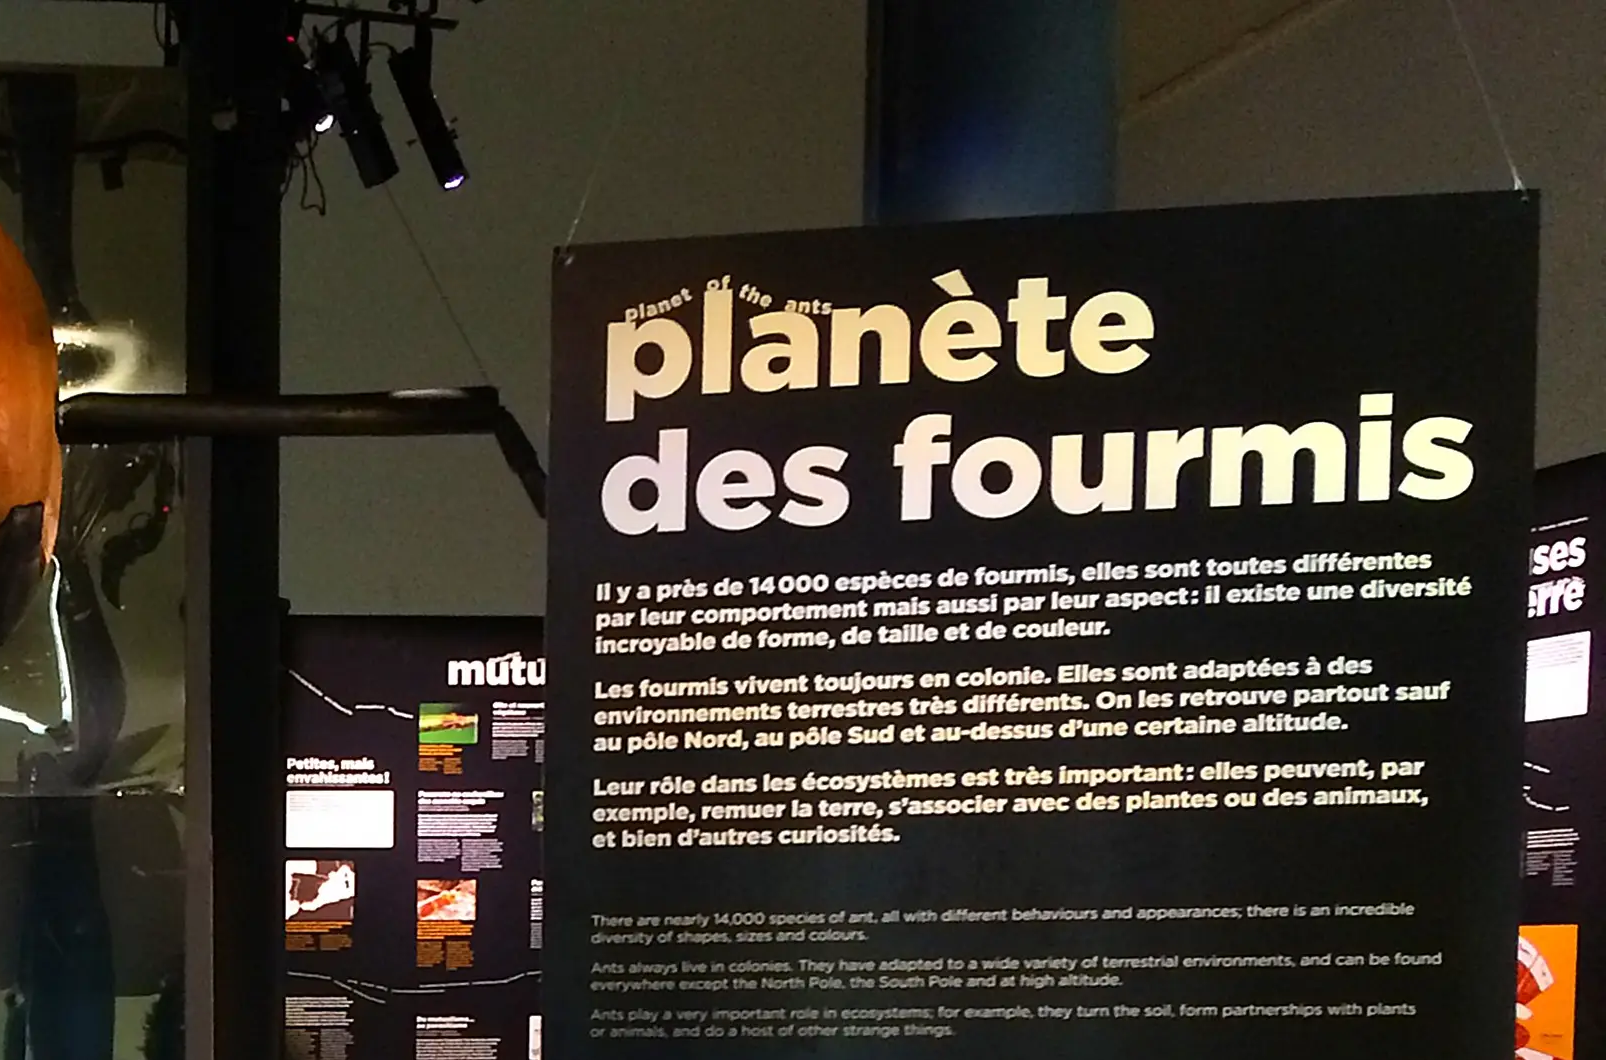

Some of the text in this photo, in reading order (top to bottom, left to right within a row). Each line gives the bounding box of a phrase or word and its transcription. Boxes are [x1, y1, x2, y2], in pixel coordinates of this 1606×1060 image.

[706, 274, 732, 291] of
[739, 283, 773, 308] the
[784, 298, 834, 315] ants
[603, 269, 1155, 422] planète
[600, 392, 1476, 535] des fourmis
[596, 582, 611, 601] Il
[616, 586, 632, 604] y
[636, 585, 651, 600] a
[656, 578, 708, 602] près
[713, 577, 744, 596] de
[835, 570, 932, 594] espèces
[937, 568, 969, 587] de
[974, 564, 1076, 586] fourmis,
[1081, 562, 1139, 581] elles
[1144, 559, 1201, 579] sont
[1206, 557, 1287, 576] toutes
[1292, 552, 1432, 573] différentes
[596, 612, 636, 631] par
[640, 607, 686, 626] leur
[691, 600, 868, 626] comportement
[873, 596, 931, 617] mais
[935, 593, 998, 614] aussi
[1003, 596, 1046, 615] par
[1051, 591, 1100, 610] leur
[1205, 585, 1220, 604] il
[1226, 583, 1301, 603] existe
[1307, 585, 1354, 601] une
[1360, 576, 1472, 599] diversité
[595, 618, 1111, 655] incroyable de forme, de taille et de couleur.
[595, 656, 1373, 699] Les fourmis vivent toujours en colonie. Elles sont adaptées à des
[594, 681, 1451, 725] environnements terrestres très différents. On les retrouve partout sauf
[593, 712, 1348, 754] au pôle Nord, au pôle Sud et au-dessus d'une certaine altitude.
[593, 778, 645, 796] Leur
[650, 776, 696, 795] rôle
[701, 775, 757, 793] dans
[763, 773, 796, 792] les
[801, 769, 956, 793] écosystèmes
[961, 768, 999, 787] est
[1004, 766, 1053, 786] très
[1200, 761, 1258, 780] elles
[1264, 759, 1375, 783] peuvent,
[1381, 761, 1425, 780] par
[592, 786, 1428, 824] exemple, remuer la terre, s'associer avec des plantes ou des animaux,
[592, 823, 900, 848] et bien d'autres curiosités.
[591, 914, 633, 927] There
[637, 916, 661, 927] are
[664, 913, 710, 928] nearly
[714, 912, 766, 926] 14,000
[769, 912, 826, 925] species
[828, 910, 846, 924] of
[881, 910, 900, 923] all
[903, 910, 938, 923] with
[940, 908, 1008, 922] different
[1011, 907, 1098, 921] behaviours
[1101, 906, 1133, 919] and
[1247, 905, 1289, 917] there
[1293, 904, 1307, 917] is
[1310, 906, 1331, 916] an
[1334, 902, 1415, 916] incredible
[590, 978, 675, 992] everywhere
[679, 978, 729, 991] except
[732, 978, 758, 990] the
[761, 977, 805, 989] North
[849, 976, 875, 989] the
[879, 975, 925, 988] South
[928, 975, 963, 988] Pole
[966, 975, 997, 987] and
[1000, 975, 1016, 987] at
[1019, 974, 1055, 989] high
[591, 962, 625, 974] Ants
[628, 962, 678, 976] always
[681, 961, 708, 973] live
[711, 961, 725, 972] in
[798, 959, 835, 974] They
[838, 959, 876, 971] have
[878, 958, 944, 972] adapted
[947, 958, 965, 970] to
[967, 960, 978, 970] a
[981, 957, 1020, 970] wide
[1023, 956, 1078, 971] variety
[1080, 955, 1099, 969] of
[1102, 955, 1179, 968] terrestrial
[1300, 953, 1332, 966] and
[1335, 956, 1365, 966] can
[1369, 953, 1390, 965] be
[1394, 952, 1442, 965] found
